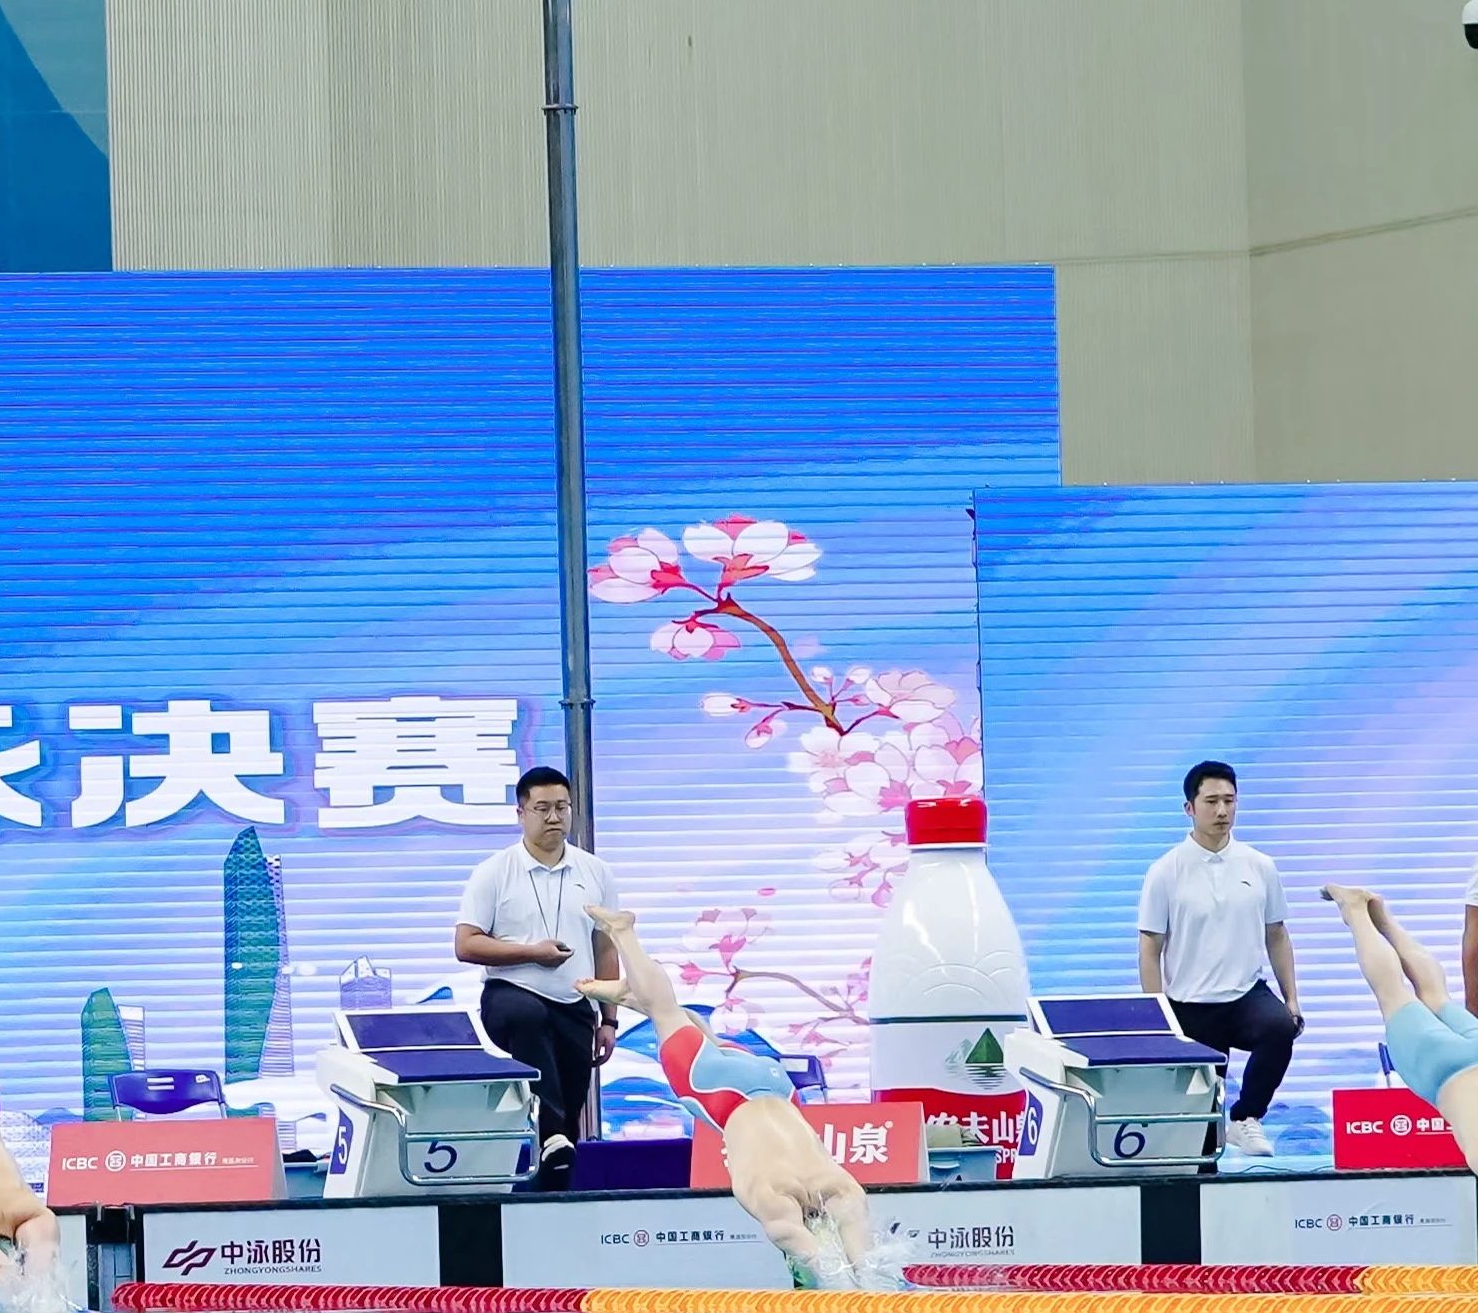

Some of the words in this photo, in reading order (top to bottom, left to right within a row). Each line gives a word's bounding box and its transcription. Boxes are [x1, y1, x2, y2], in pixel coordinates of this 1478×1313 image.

[1026, 1106, 1039, 1146] 6
[1346, 1120, 1384, 1135] ICBC
[338, 1131, 348, 1166] 5
[1113, 1121, 1146, 1158] 6
[61, 1156, 98, 1172] ICBC
[129, 1151, 218, 1169] 中国工商银行
[424, 1139, 458, 1174] 5
[1294, 1218, 1323, 1230] ICBC
[1348, 1213, 1415, 1227] 中国工商银行
[600, 1234, 630, 1246] ICBC
[655, 1229, 725, 1243] 中国工商银行
[928, 1225, 1015, 1250] 中泳股份
[220, 1237, 322, 1265] 中泳股份
